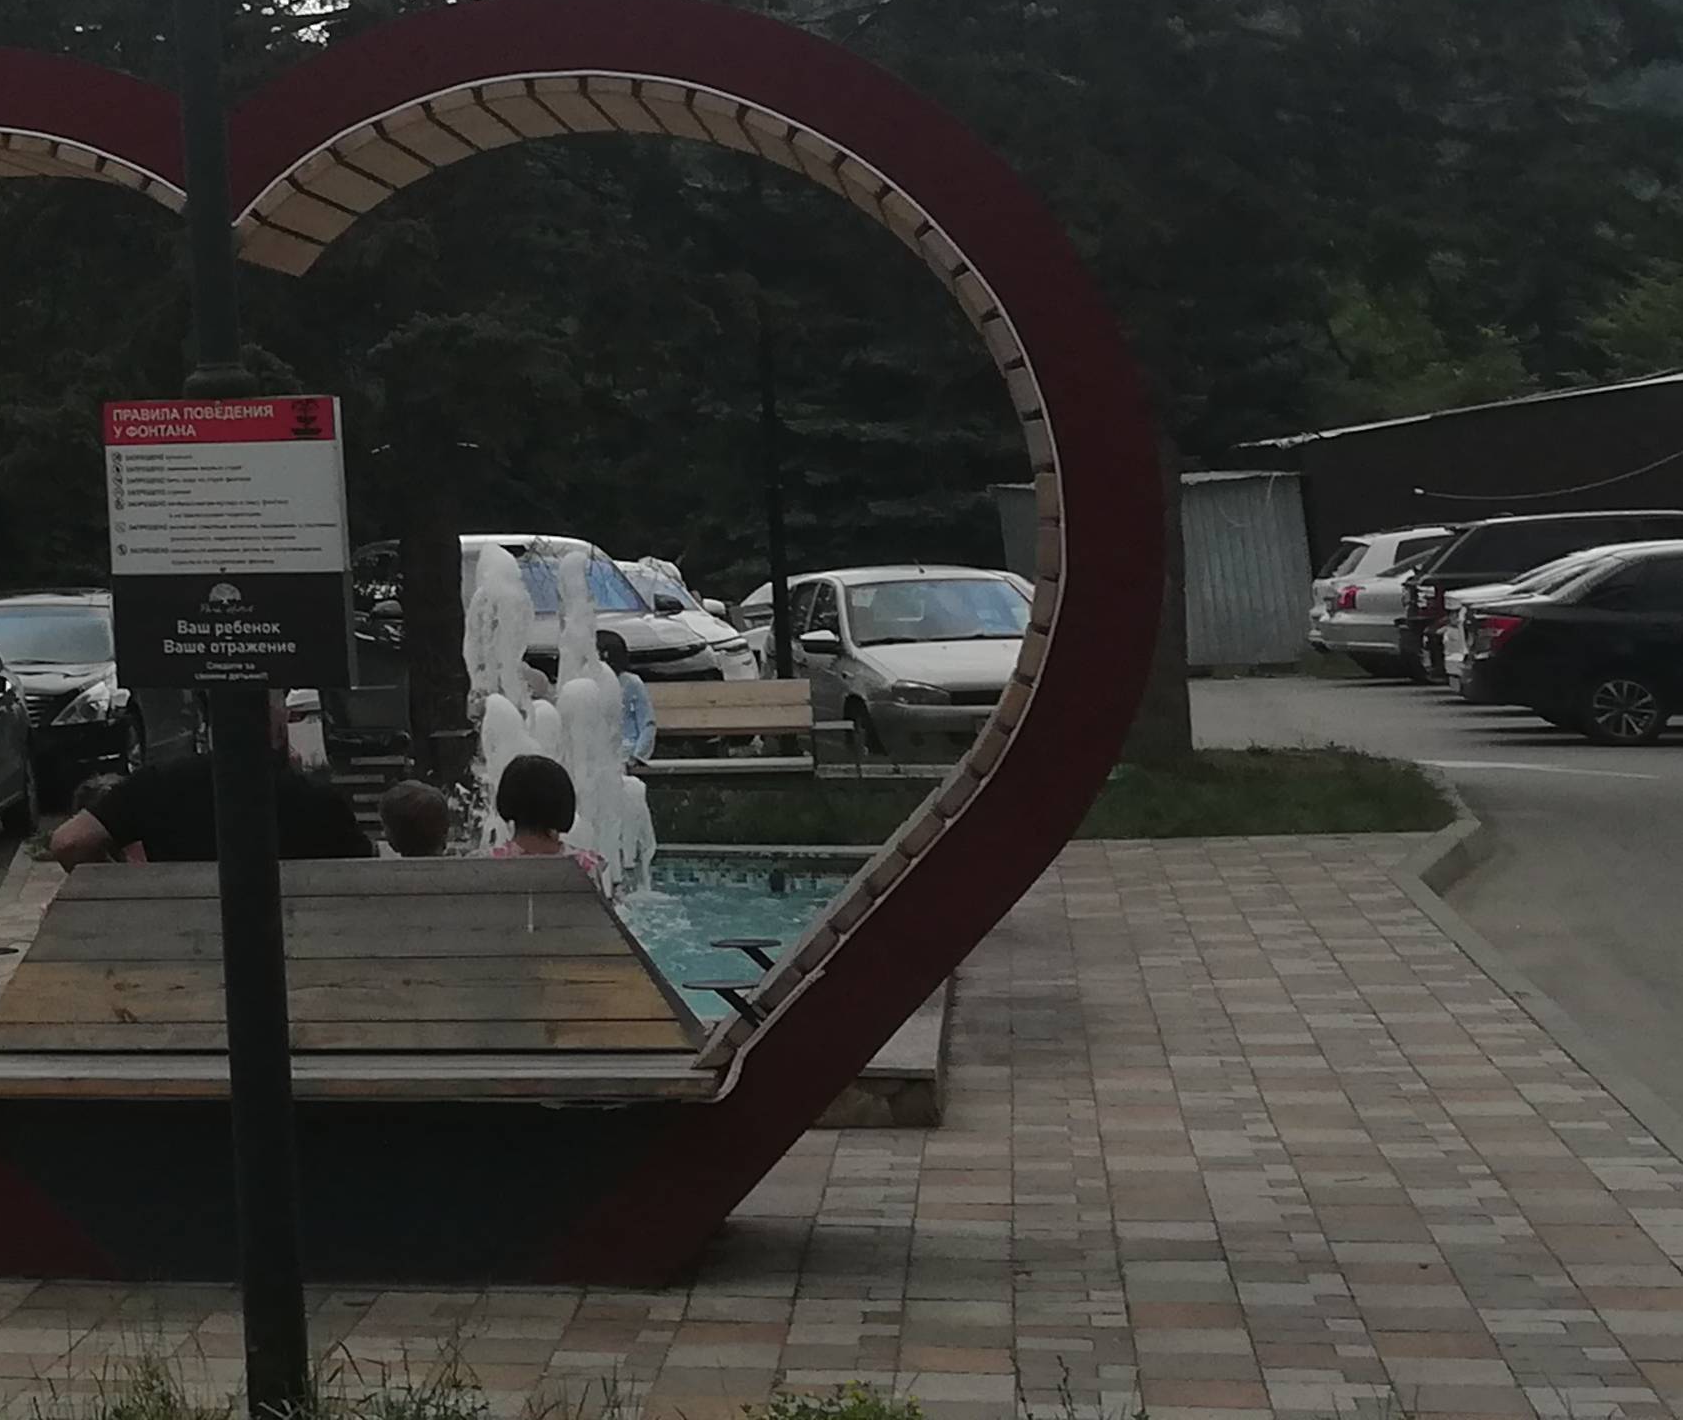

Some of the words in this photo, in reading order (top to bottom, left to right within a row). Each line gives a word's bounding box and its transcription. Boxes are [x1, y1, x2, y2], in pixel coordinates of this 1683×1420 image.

[112, 407, 181, 422] ПРАВИЛА
[183, 404, 274, 421] ПОВЕДЕНИЯ
[112, 426, 123, 439] У
[125, 424, 197, 438] ФОНТАНА
[176, 620, 211, 635] Ваш
[214, 620, 281, 637] ребенок
[163, 638, 206, 655] Ваше
[209, 641, 297, 657] отражение
